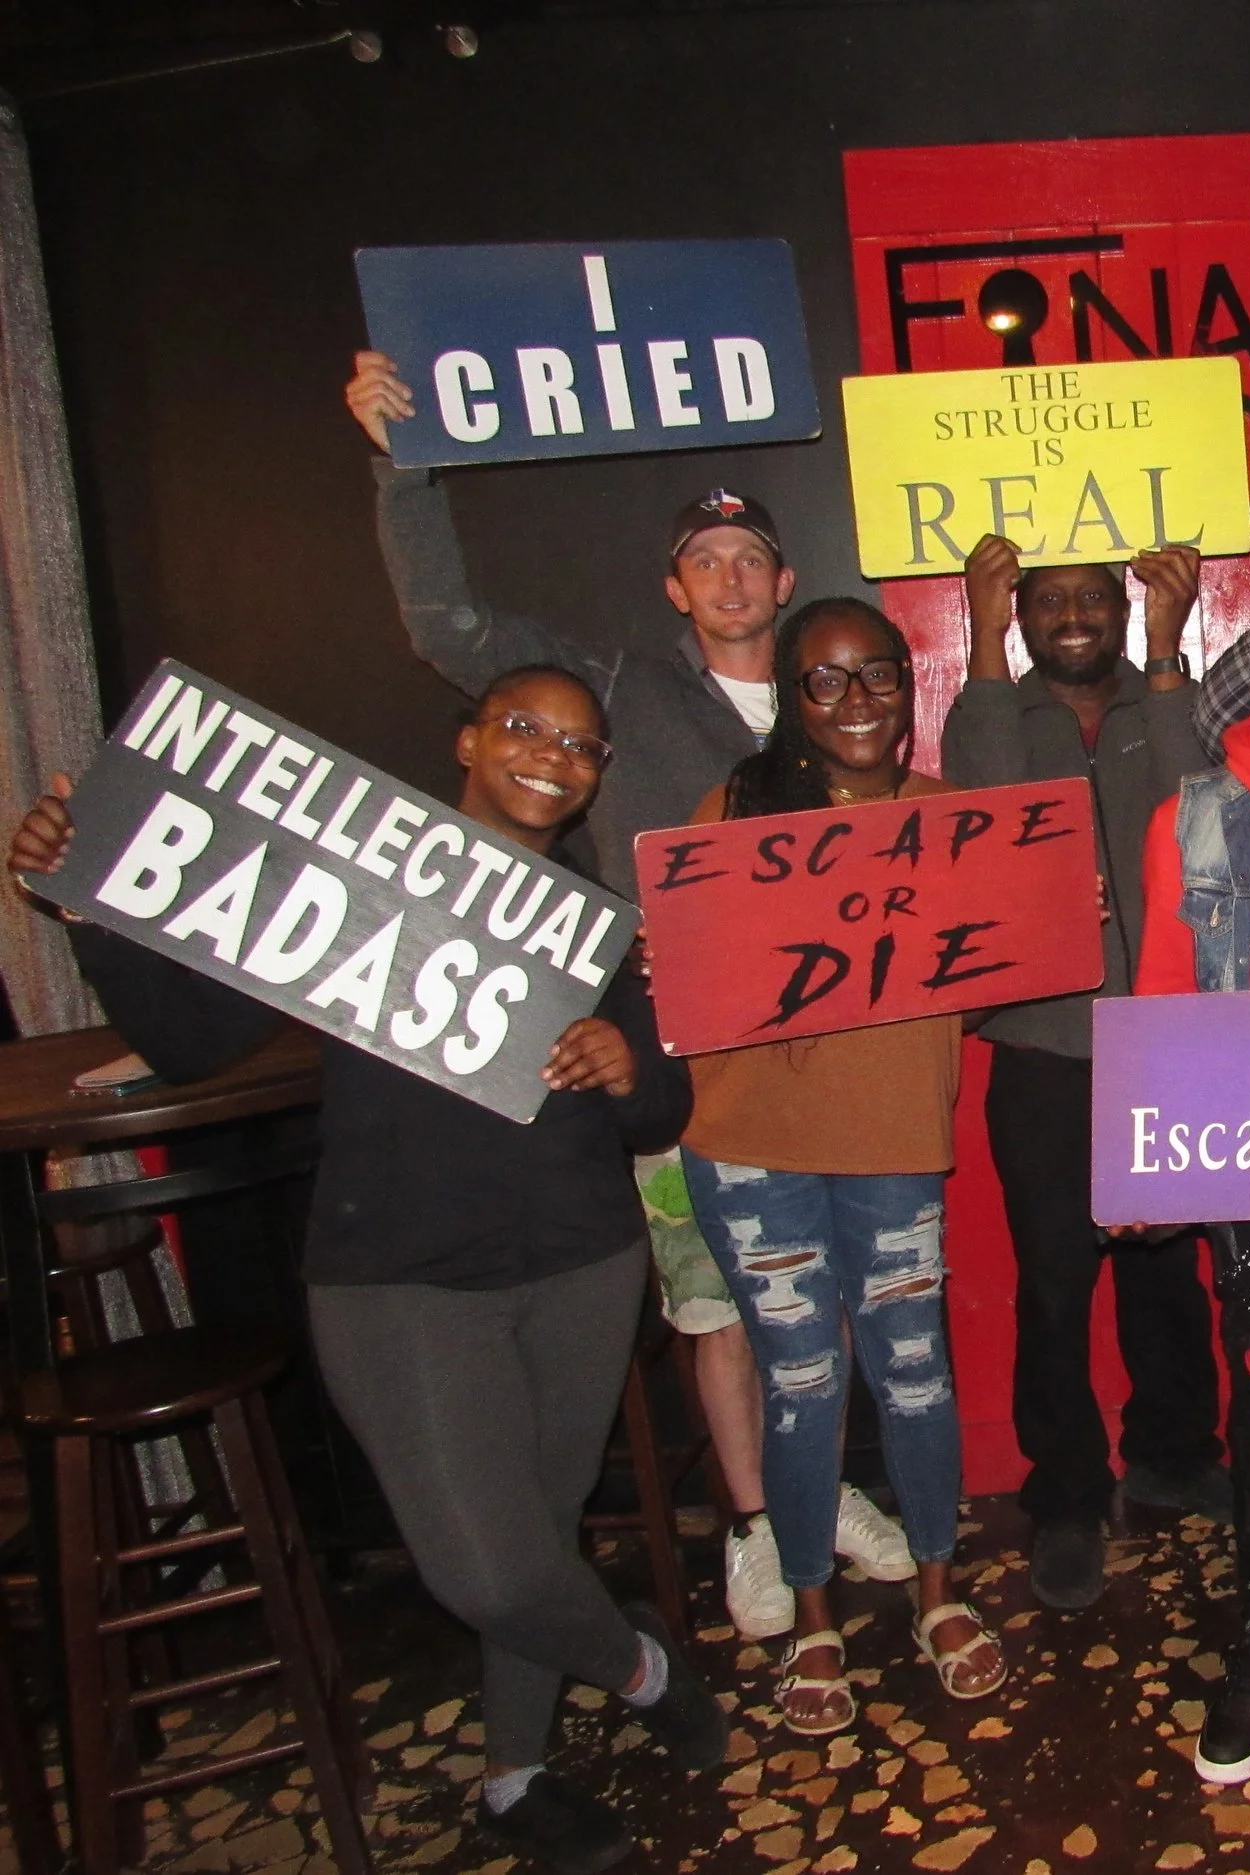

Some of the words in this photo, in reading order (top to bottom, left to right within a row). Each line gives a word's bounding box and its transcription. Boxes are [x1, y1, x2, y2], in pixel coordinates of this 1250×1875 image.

[582, 255, 616, 332] I
[433, 337, 776, 444] CRIED
[935, 400, 1153, 440] STRUGGLE
[1001, 371, 1081, 403] THE
[1032, 438, 1065, 467] IS
[896, 466, 1204, 565] REAL
[124, 675, 616, 988] INTELLECTUAL
[655, 800, 1080, 891] ESCAPE
[96, 791, 530, 1076] BADASS
[838, 886, 918, 923] OR
[735, 921, 1024, 1038] DIE
